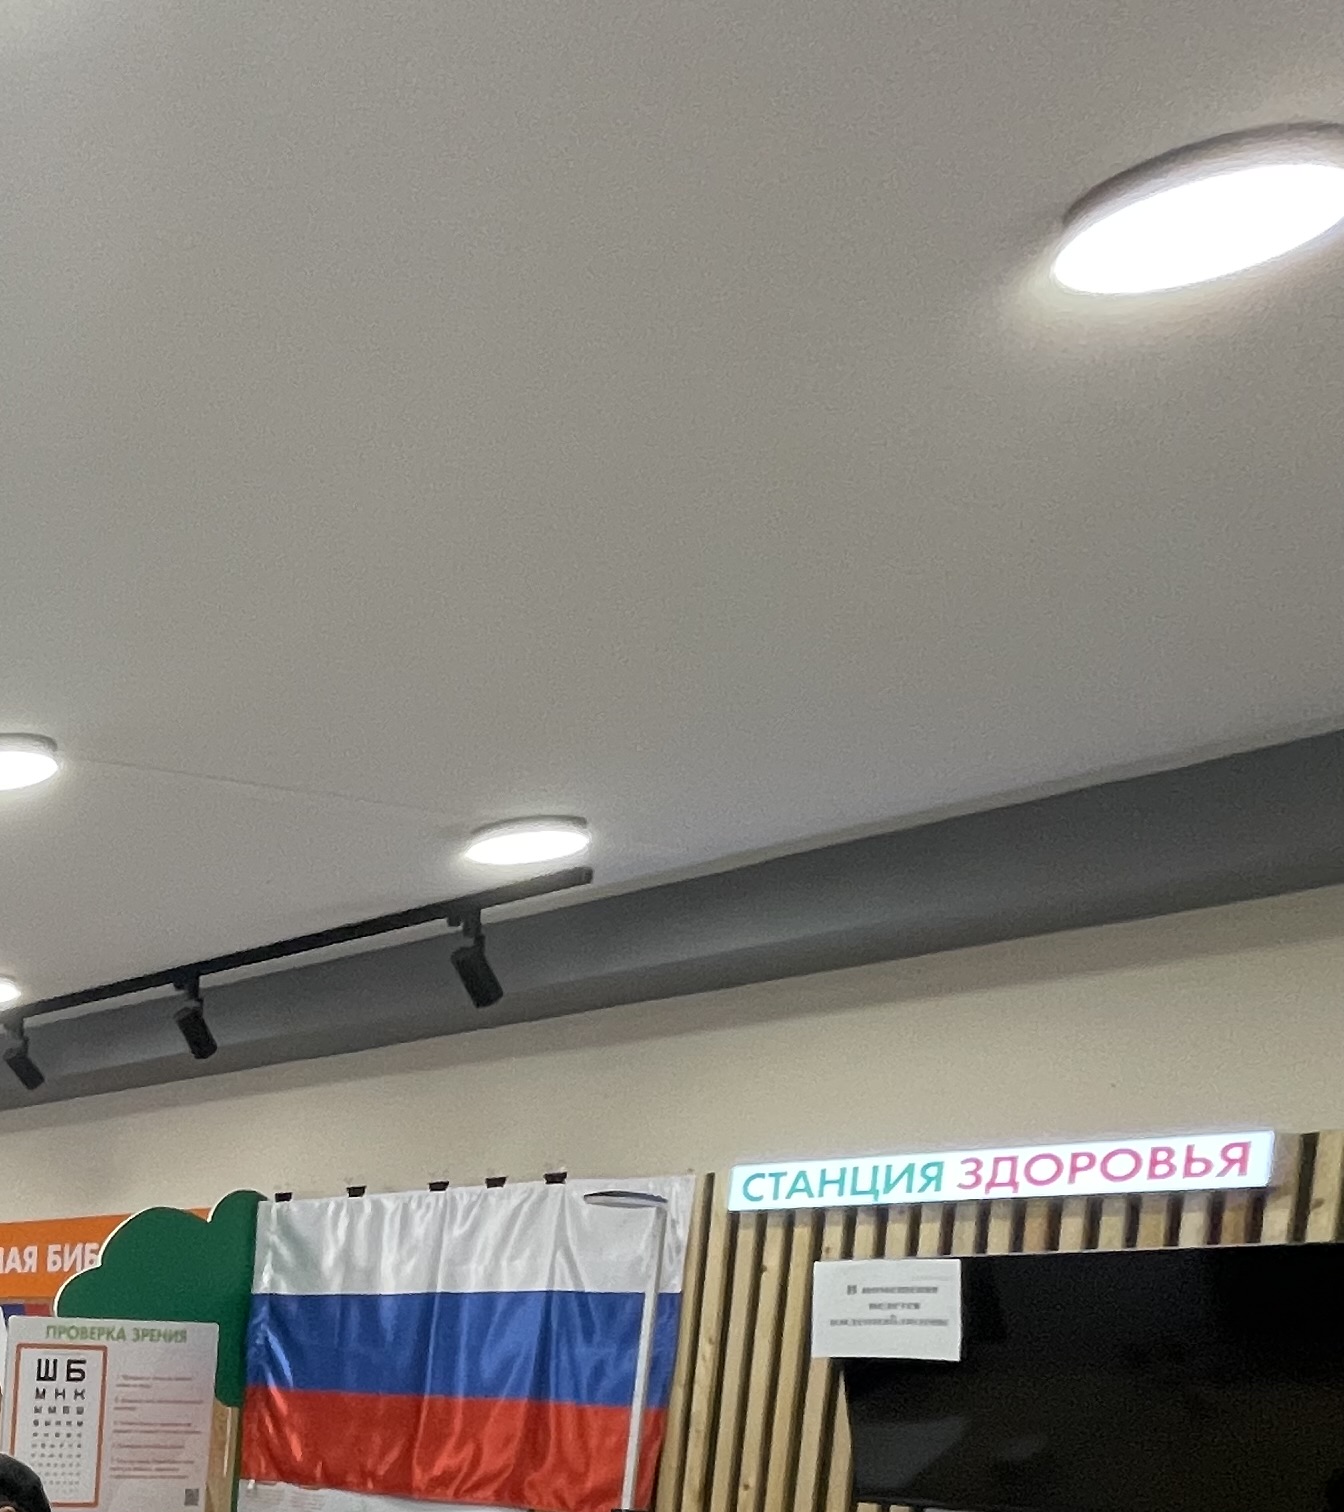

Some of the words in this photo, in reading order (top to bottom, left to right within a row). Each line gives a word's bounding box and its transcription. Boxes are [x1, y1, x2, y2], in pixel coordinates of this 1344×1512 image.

[742, 1160, 945, 1202] СТАНЦИЯ
[956, 1141, 1253, 1195] ЗДОРОВЬЯ
[45, 1325, 126, 1342] ПРОВЕРКА
[132, 1327, 188, 1343] ЗРЕНИЯ
[36, 1358, 58, 1382] Ш
[66, 1359, 87, 1382] Б
